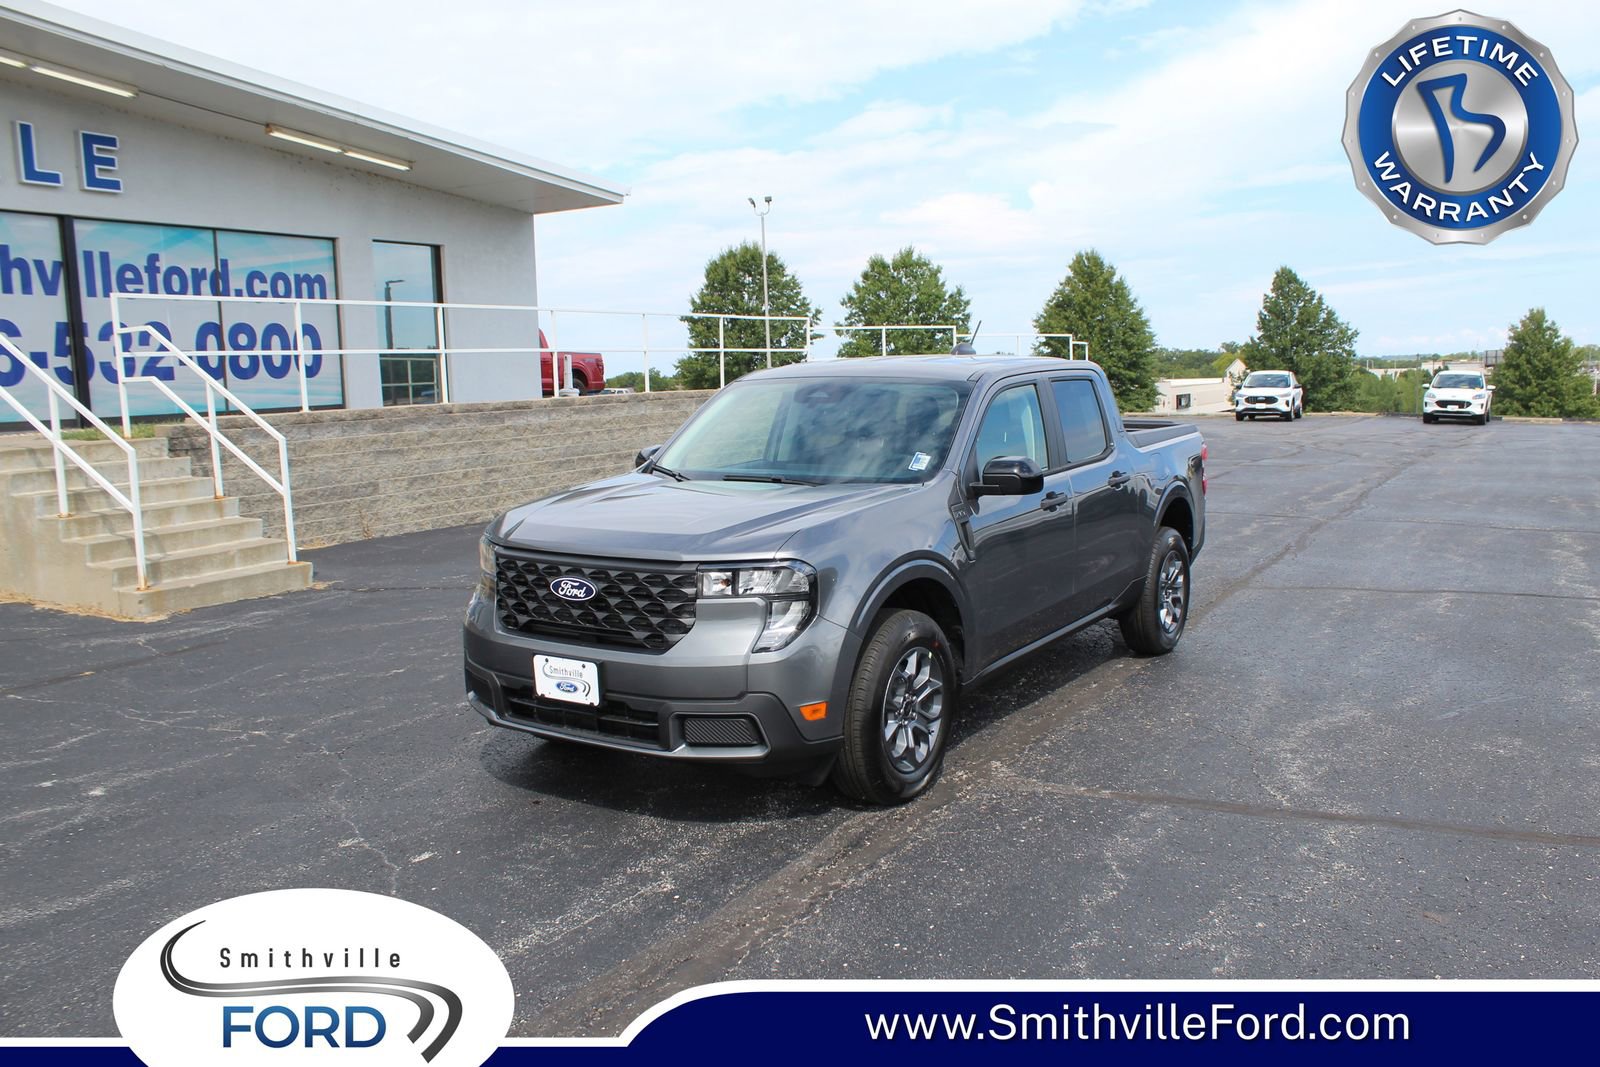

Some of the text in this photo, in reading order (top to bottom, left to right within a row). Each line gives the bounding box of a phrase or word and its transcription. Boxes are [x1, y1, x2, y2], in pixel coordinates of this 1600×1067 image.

[0, 244, 327, 302] hvlleford.com
[557, 579, 587, 598] Ford
[549, 665, 583, 679] Smithville
